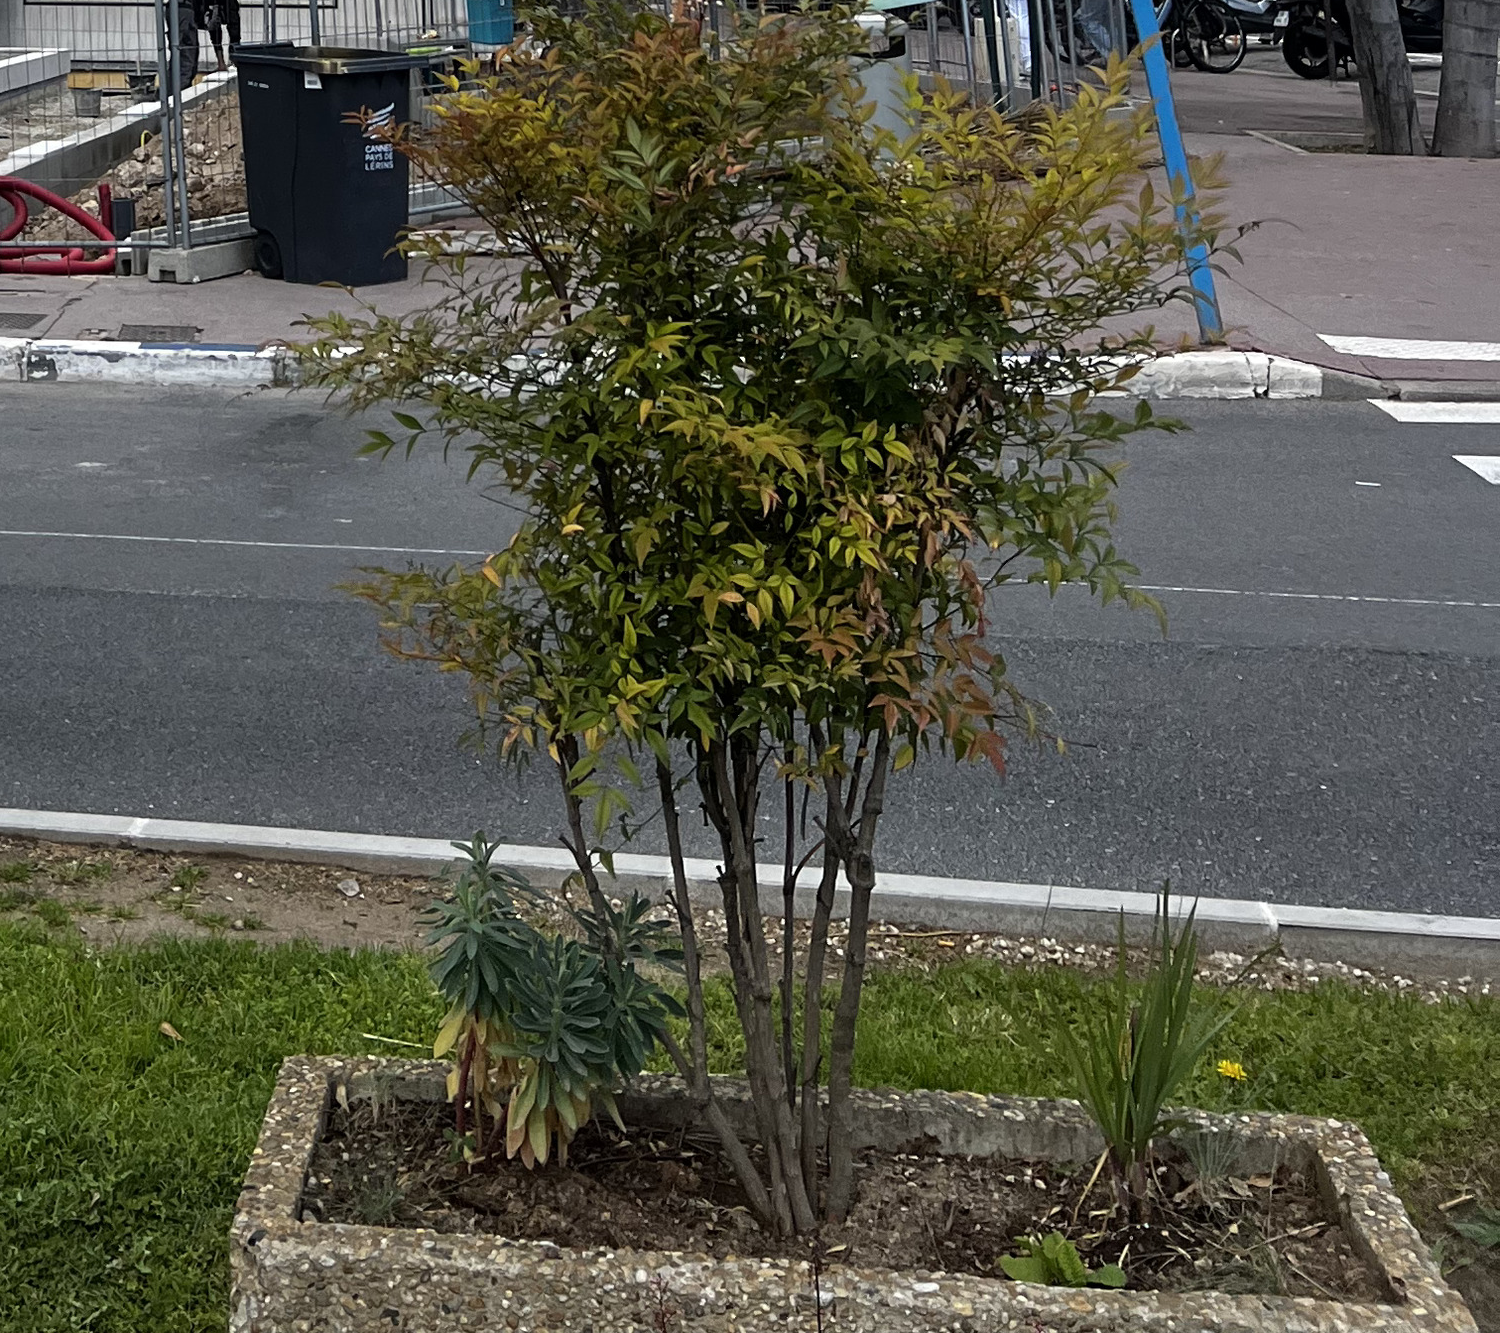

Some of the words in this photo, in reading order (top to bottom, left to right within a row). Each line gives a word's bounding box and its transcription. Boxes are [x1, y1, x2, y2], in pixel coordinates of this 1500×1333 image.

[365, 144, 393, 153] CANNES
[365, 153, 383, 162] PAYS
[384, 153, 393, 161] DE
